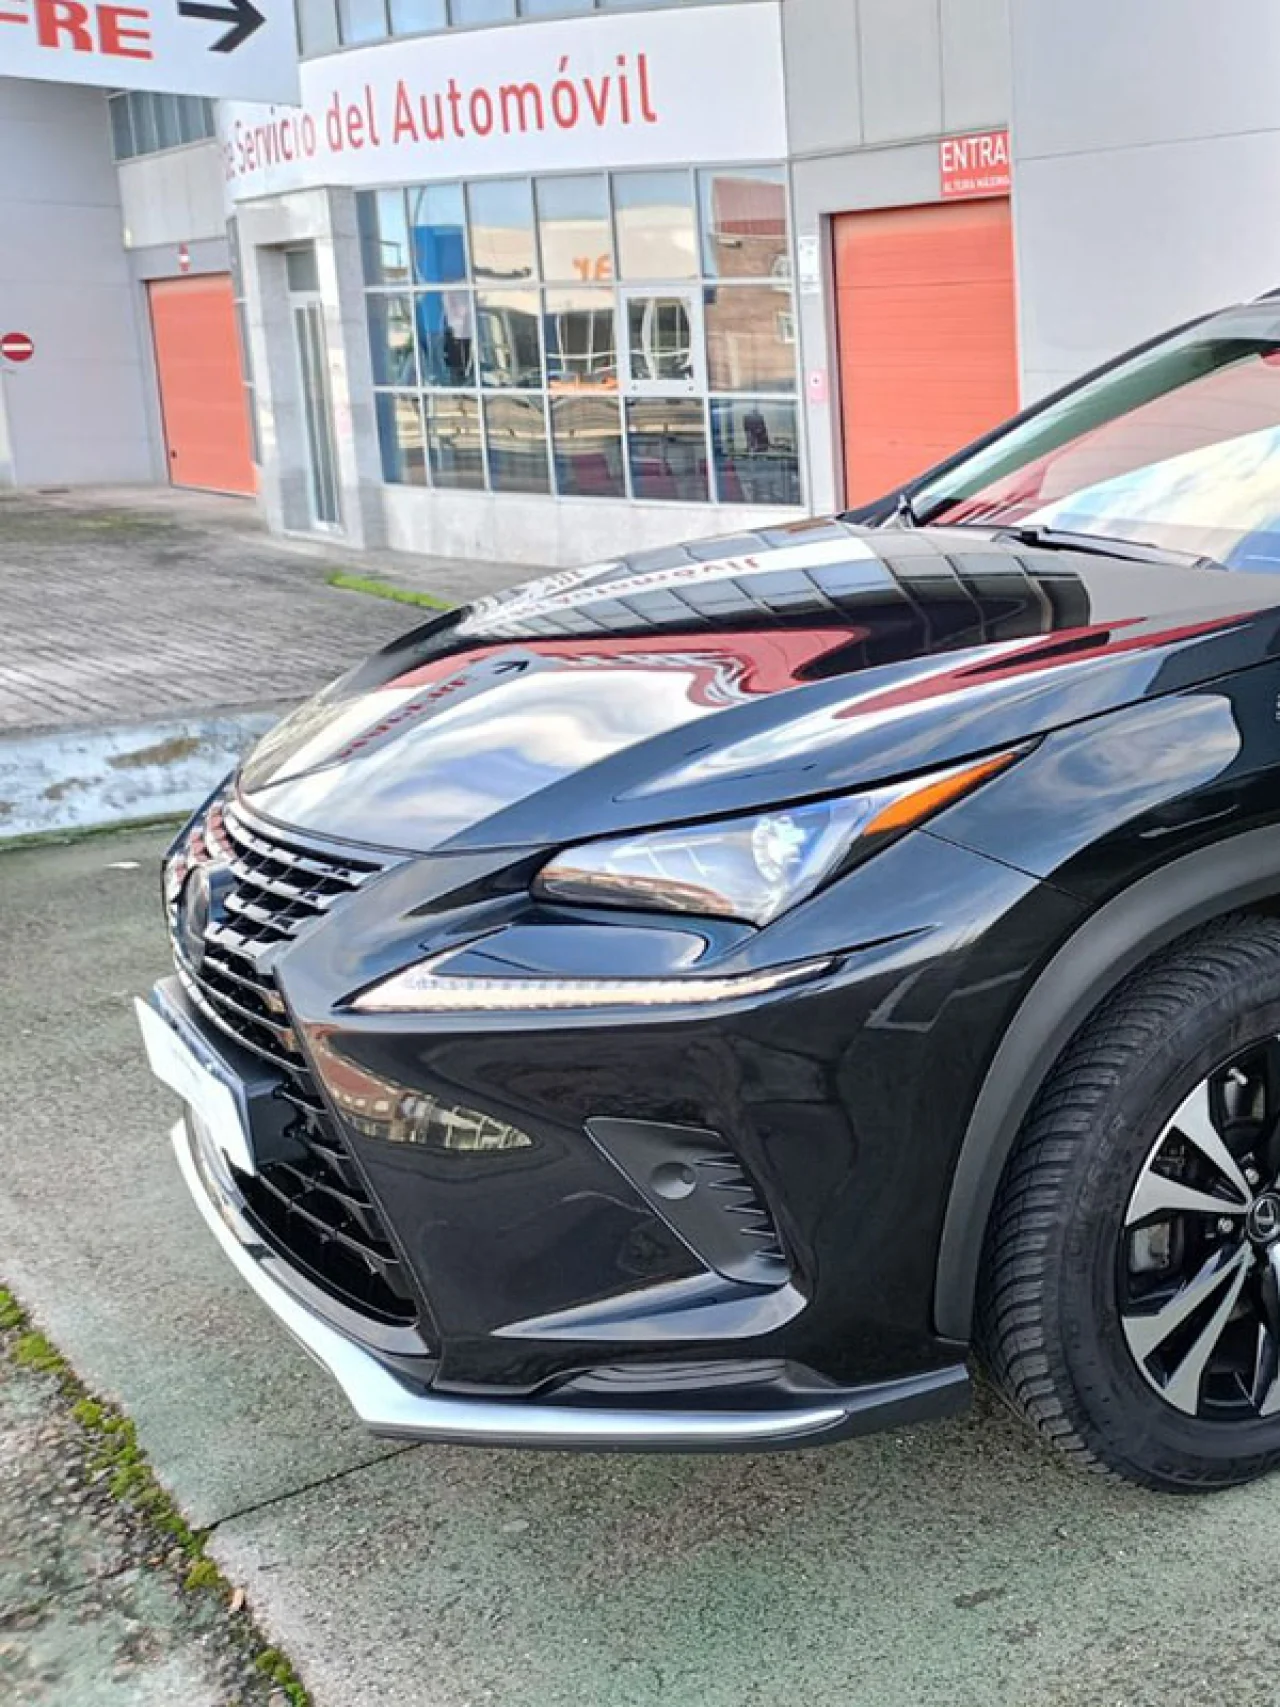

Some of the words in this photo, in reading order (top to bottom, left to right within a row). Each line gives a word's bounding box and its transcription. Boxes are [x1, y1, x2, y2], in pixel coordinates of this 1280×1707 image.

[0, 0, 153, 60] RE
[235, 105, 316, 175] Servicio
[326, 84, 380, 152] del
[393, 52, 657, 144] Automóvil
[942, 133, 1008, 172] ENTRA
